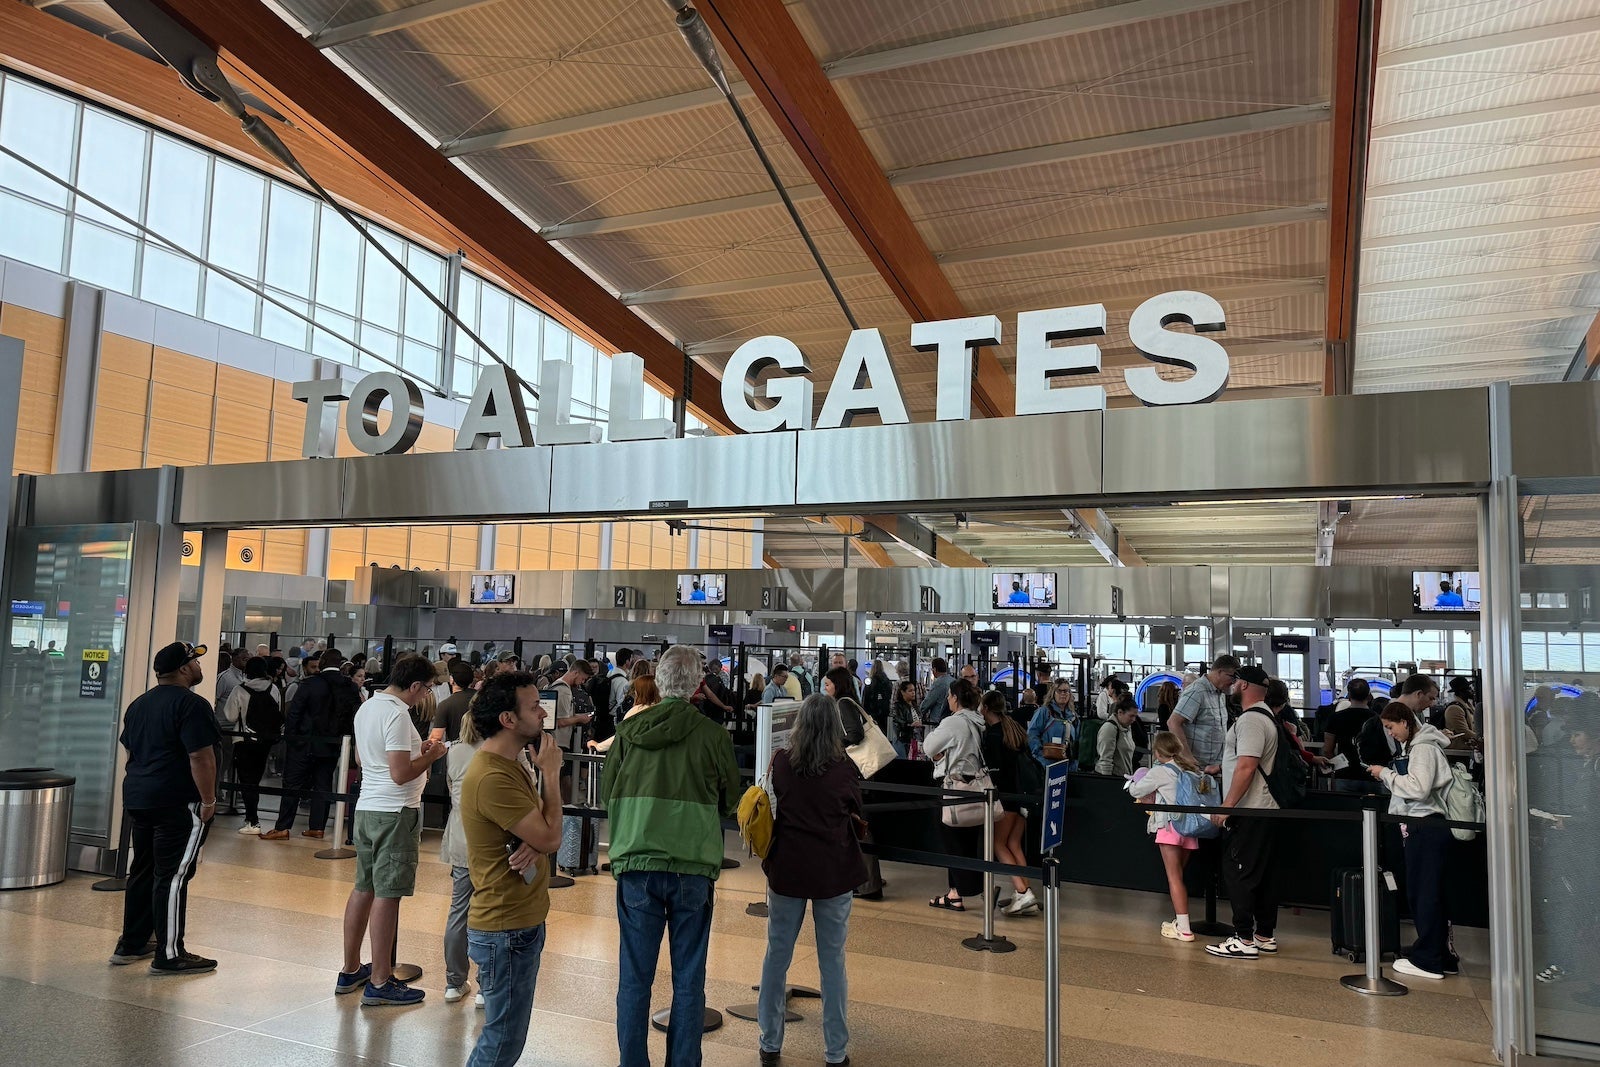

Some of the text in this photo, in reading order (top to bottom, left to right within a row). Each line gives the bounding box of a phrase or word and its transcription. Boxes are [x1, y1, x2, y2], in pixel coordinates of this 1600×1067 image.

[292, 290, 1230, 458] TO ALL GATES
[424, 589, 430, 604] 1
[616, 589, 624, 605] 2
[763, 590, 769, 606] 3
[922, 590, 927, 608] 4
[84, 651, 105, 659] NOTICE
[1052, 788, 1061, 798] Enter
[1051, 801, 1060, 809] Here
